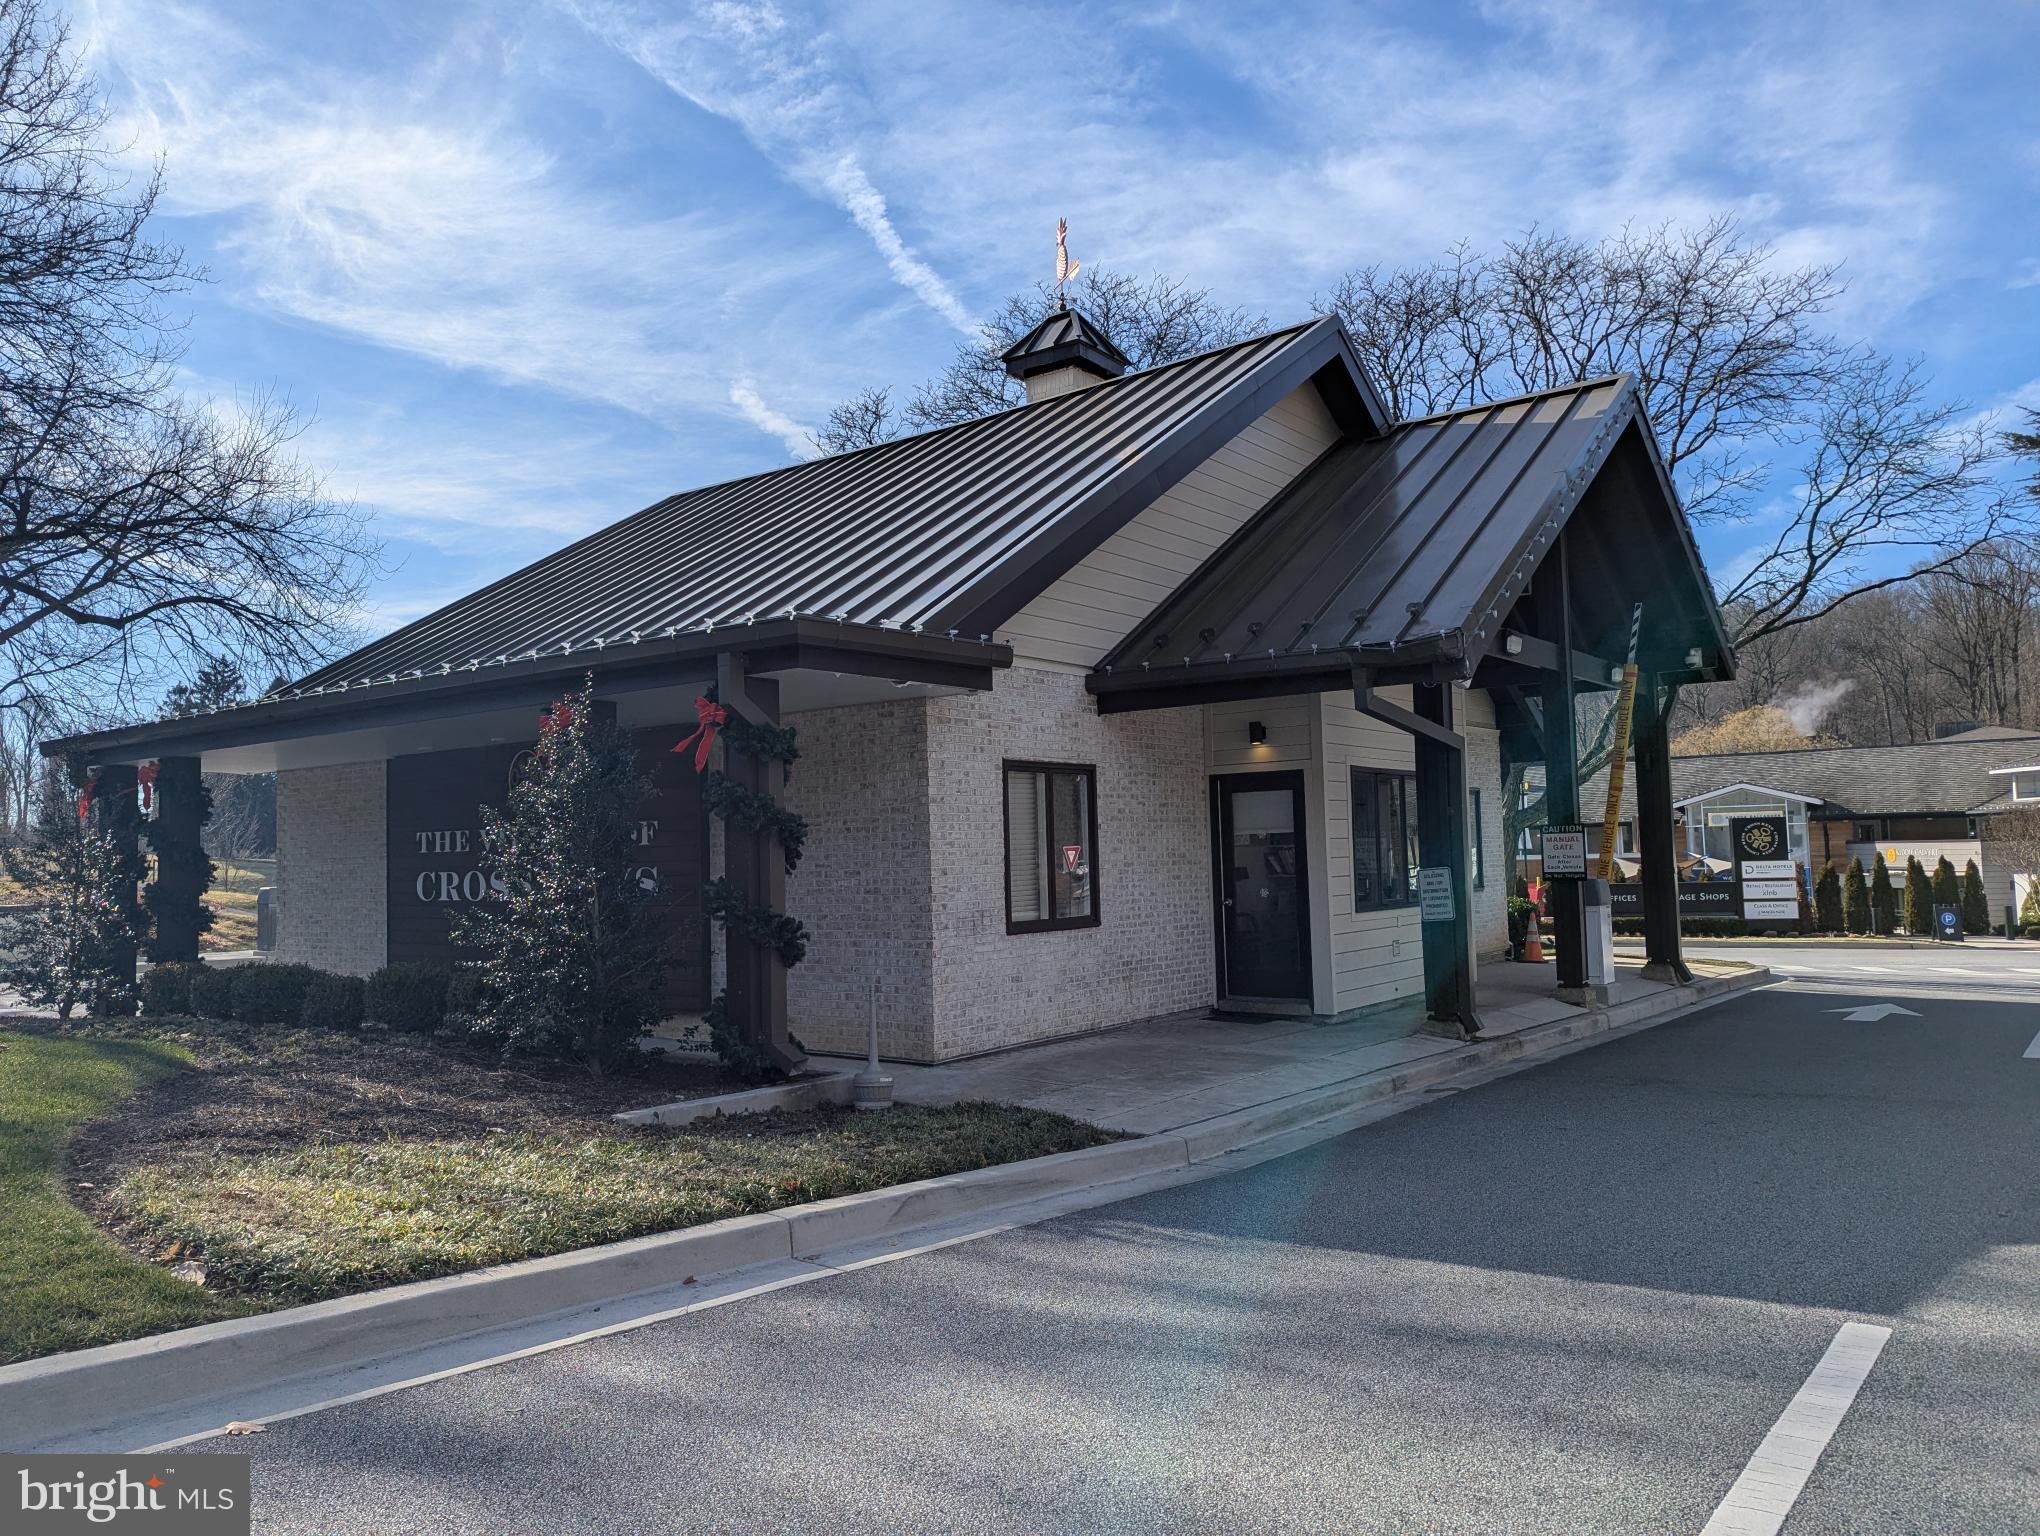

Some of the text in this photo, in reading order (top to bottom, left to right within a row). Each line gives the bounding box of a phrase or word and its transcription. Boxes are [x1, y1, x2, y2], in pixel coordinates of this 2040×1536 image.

[1615, 680, 1634, 761] ONE VEHICLE ONLY
[416, 830, 470, 853] THE
[1542, 825, 1583, 833] CAUTION
[1599, 793, 1618, 876] ONE VEHICLE ONLY
